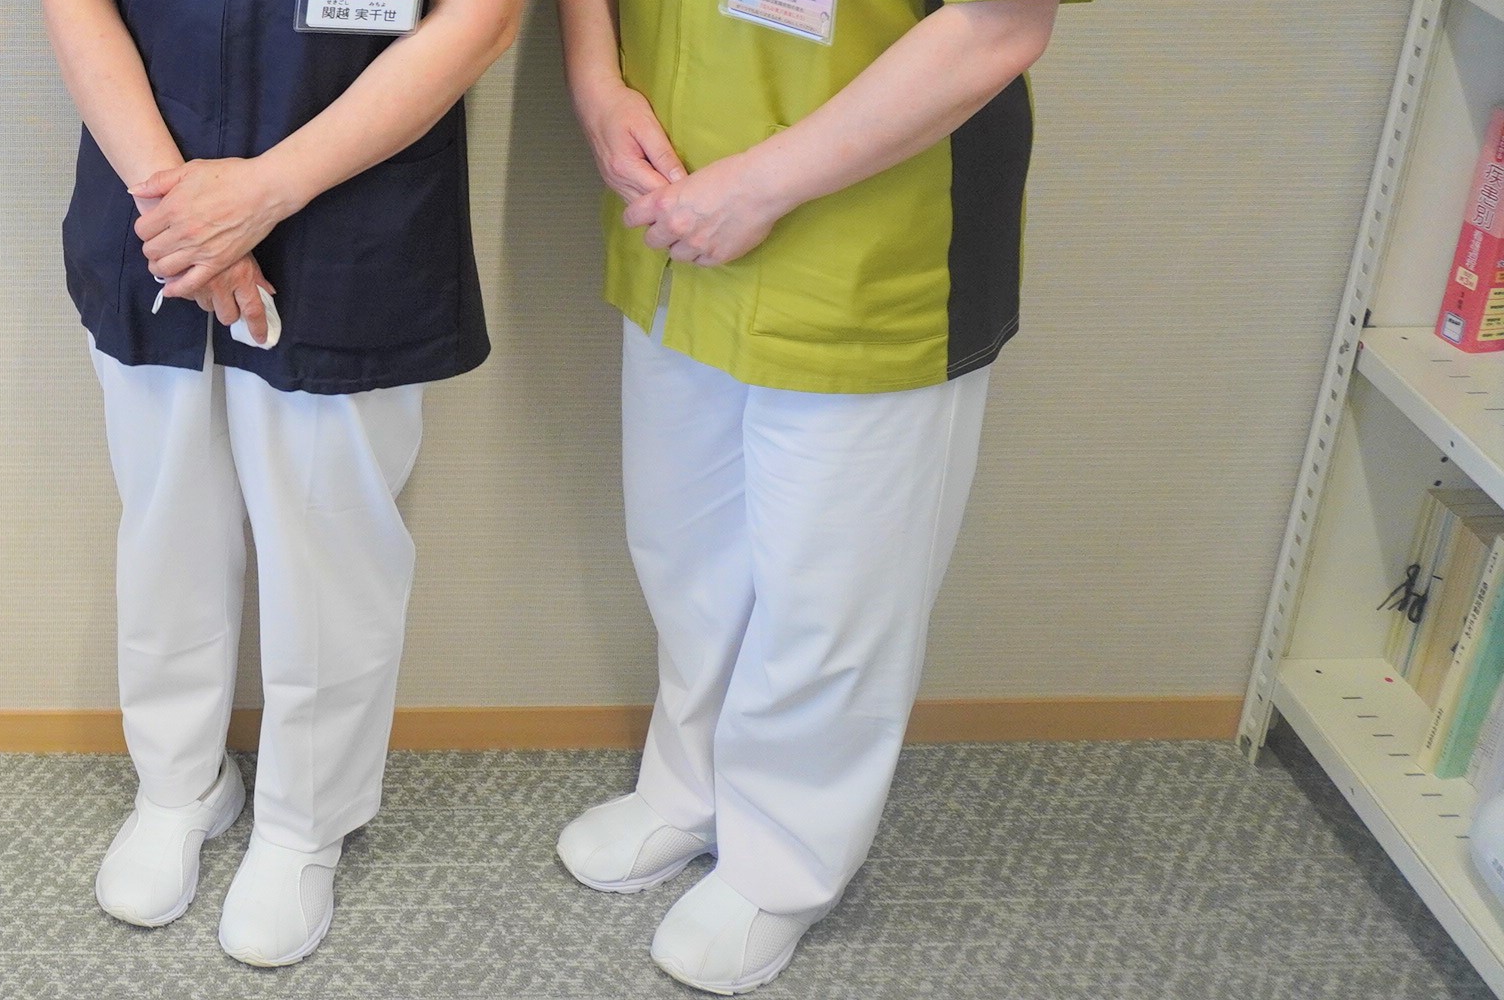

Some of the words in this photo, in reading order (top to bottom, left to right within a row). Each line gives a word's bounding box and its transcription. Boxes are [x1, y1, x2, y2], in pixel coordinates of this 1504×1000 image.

[321, 6, 351, 21] 関越
[354, 8, 397, 22] 実千世
